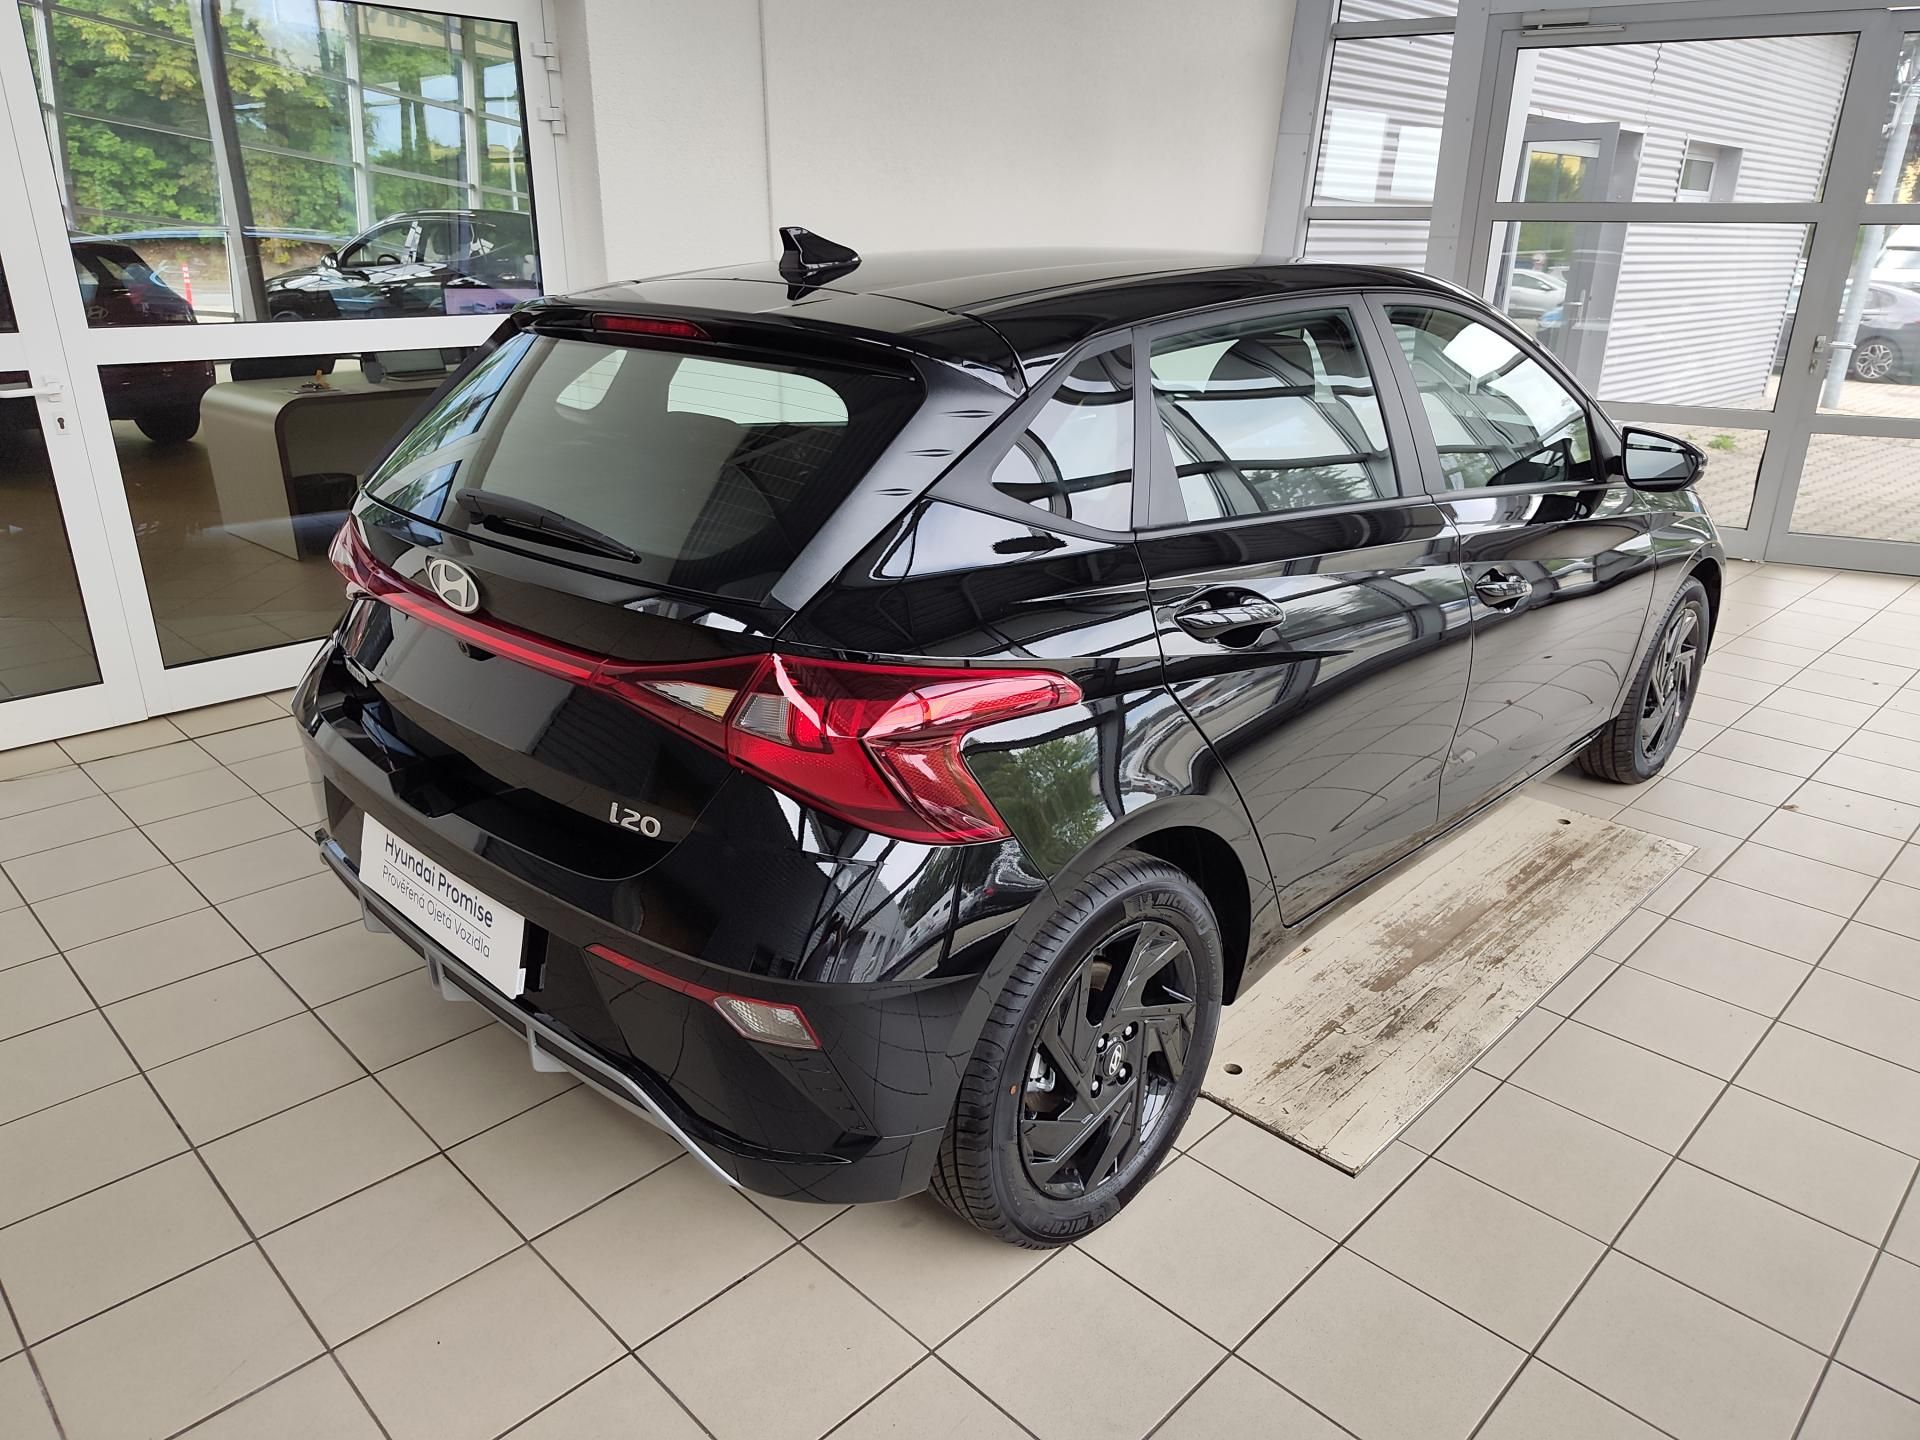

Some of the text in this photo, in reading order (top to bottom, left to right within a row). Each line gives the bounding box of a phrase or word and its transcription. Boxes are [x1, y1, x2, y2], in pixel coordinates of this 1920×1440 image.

[382, 864, 490, 959] Prověřená Ojetá Vozidla
[384, 833, 493, 929] Hyundai Promise
